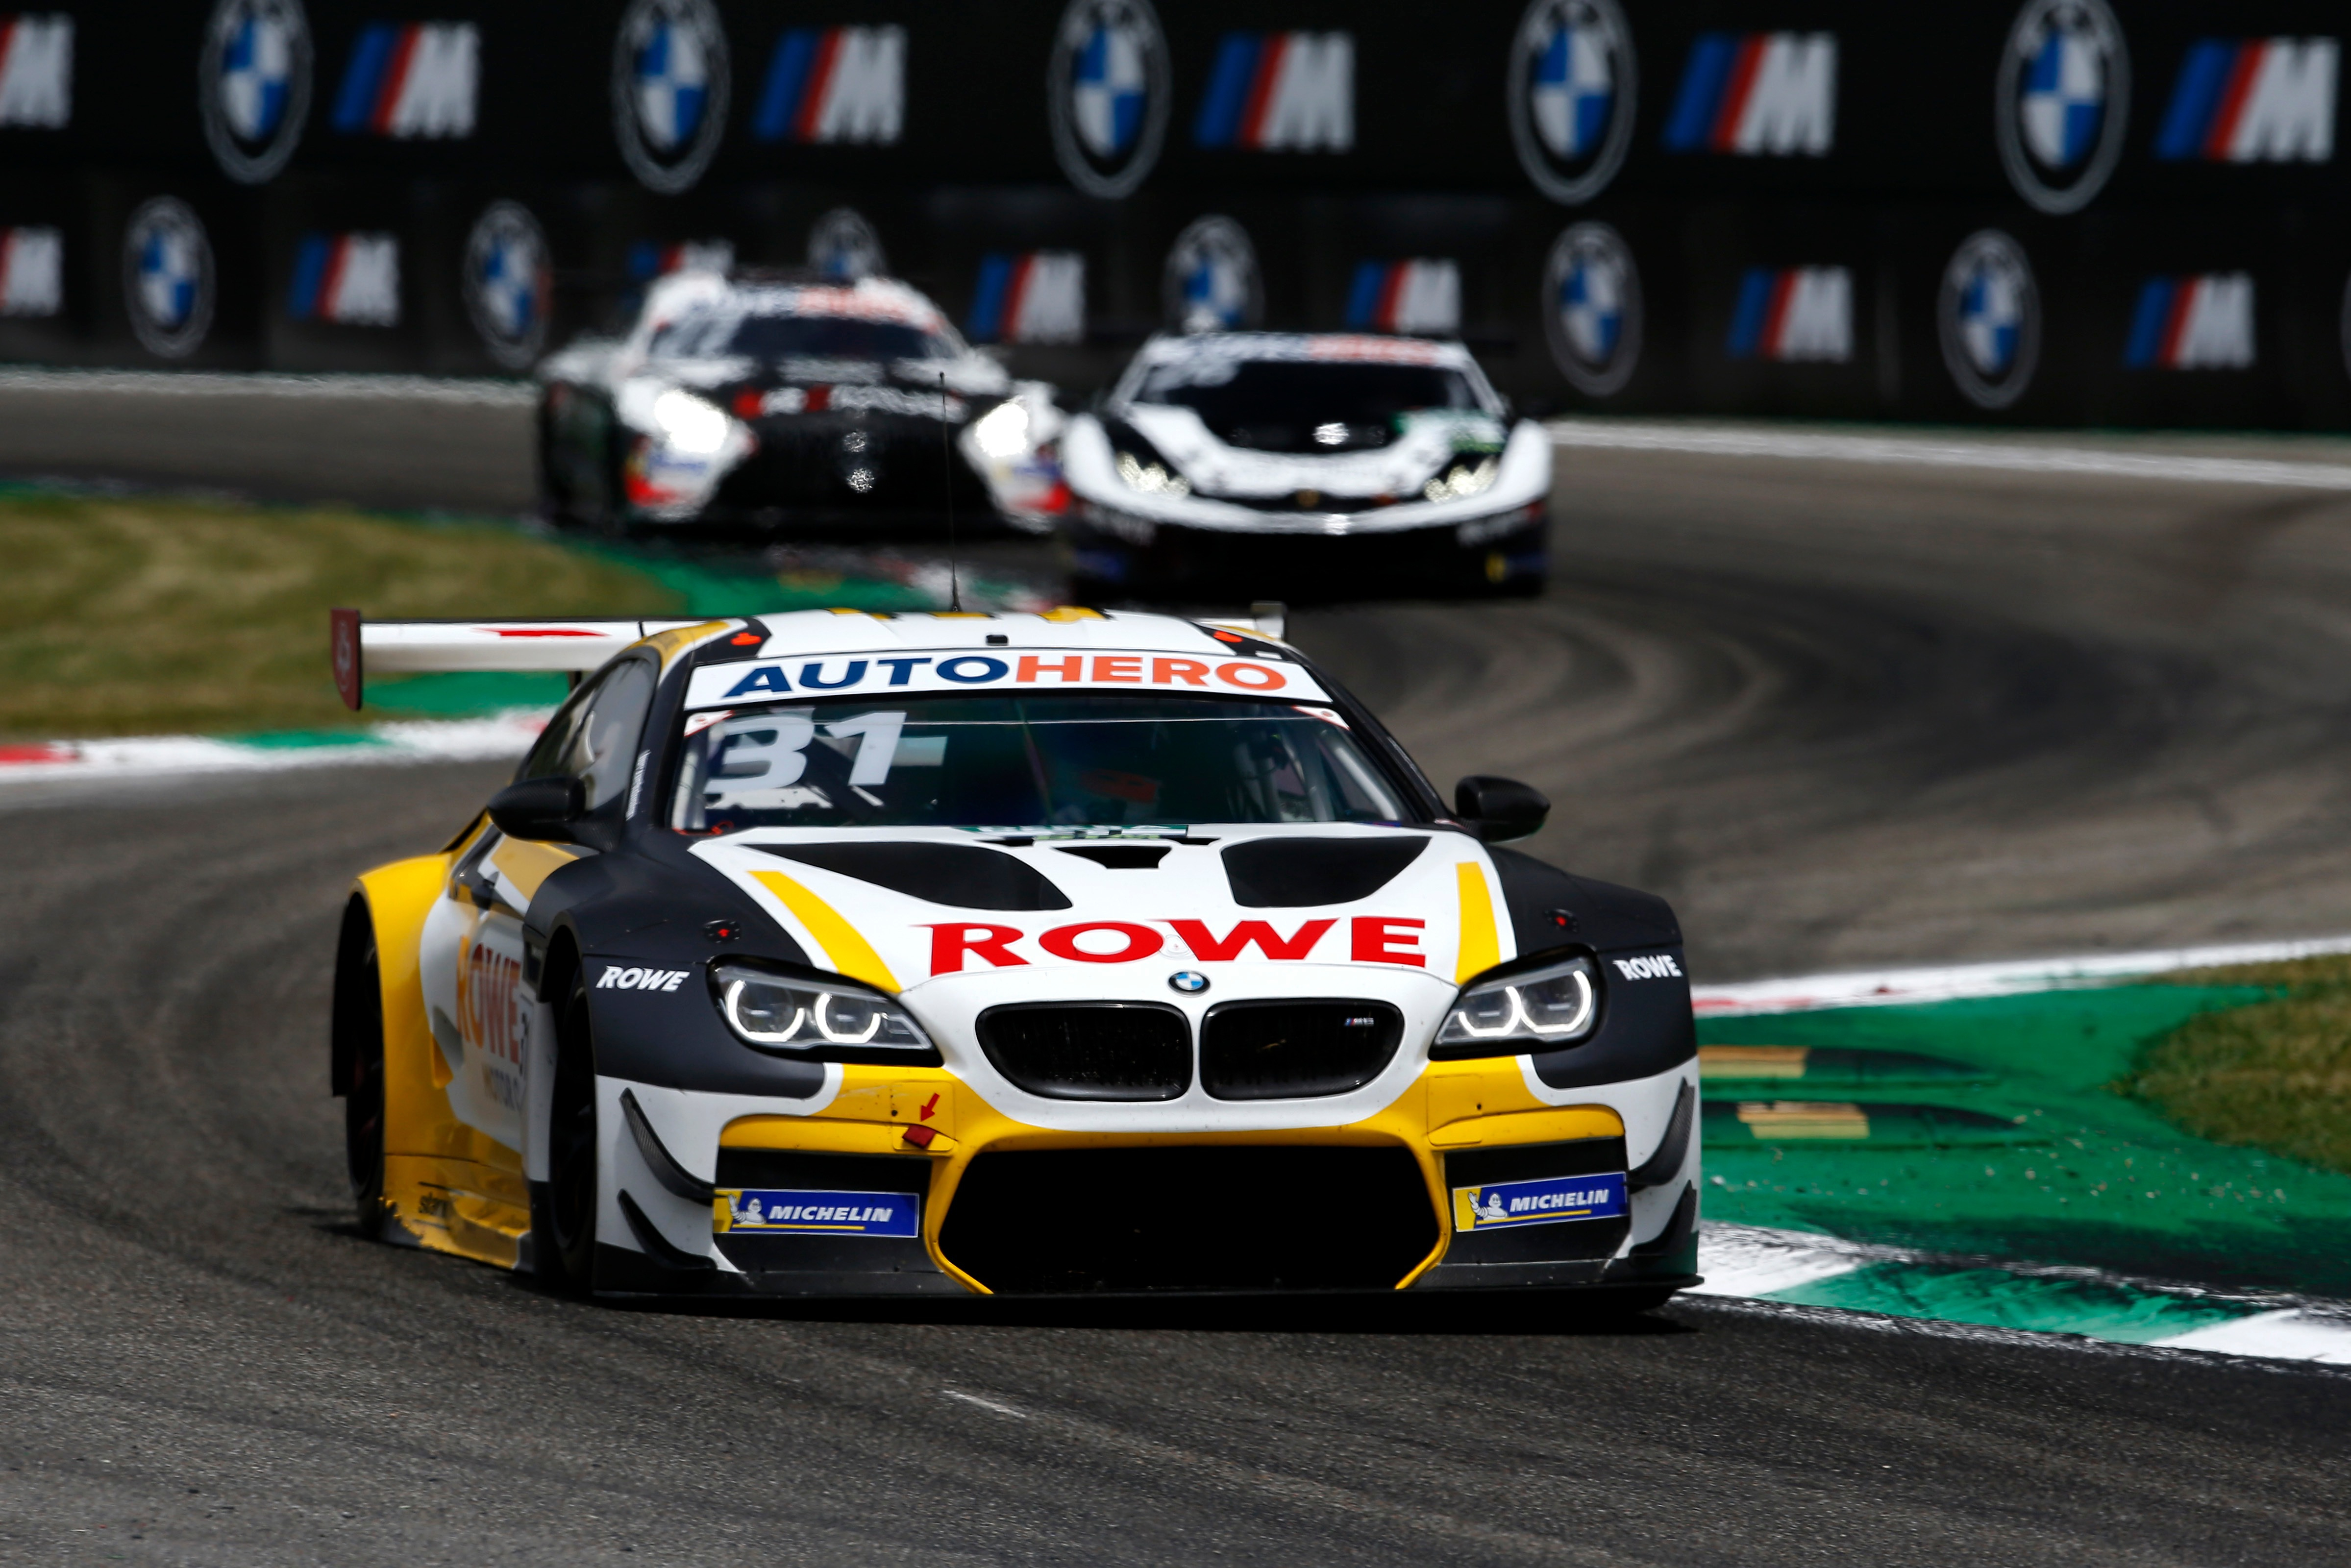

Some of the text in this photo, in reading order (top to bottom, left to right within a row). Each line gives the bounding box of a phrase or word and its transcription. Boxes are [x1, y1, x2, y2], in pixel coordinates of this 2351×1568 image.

[1259, 31, 1354, 150] M
[1732, 32, 1836, 155] M
[2227, 38, 2339, 163] M
[722, 655, 1287, 698] AUTOHERO
[704, 711, 907, 795] 31
[910, 915, 1426, 977] ROWE
[1613, 955, 1683, 980] ROWE
[595, 965, 690, 992] ROWE
[768, 1205, 893, 1223] MICHELIN
[1509, 1188, 1609, 1213] MICHELIN
